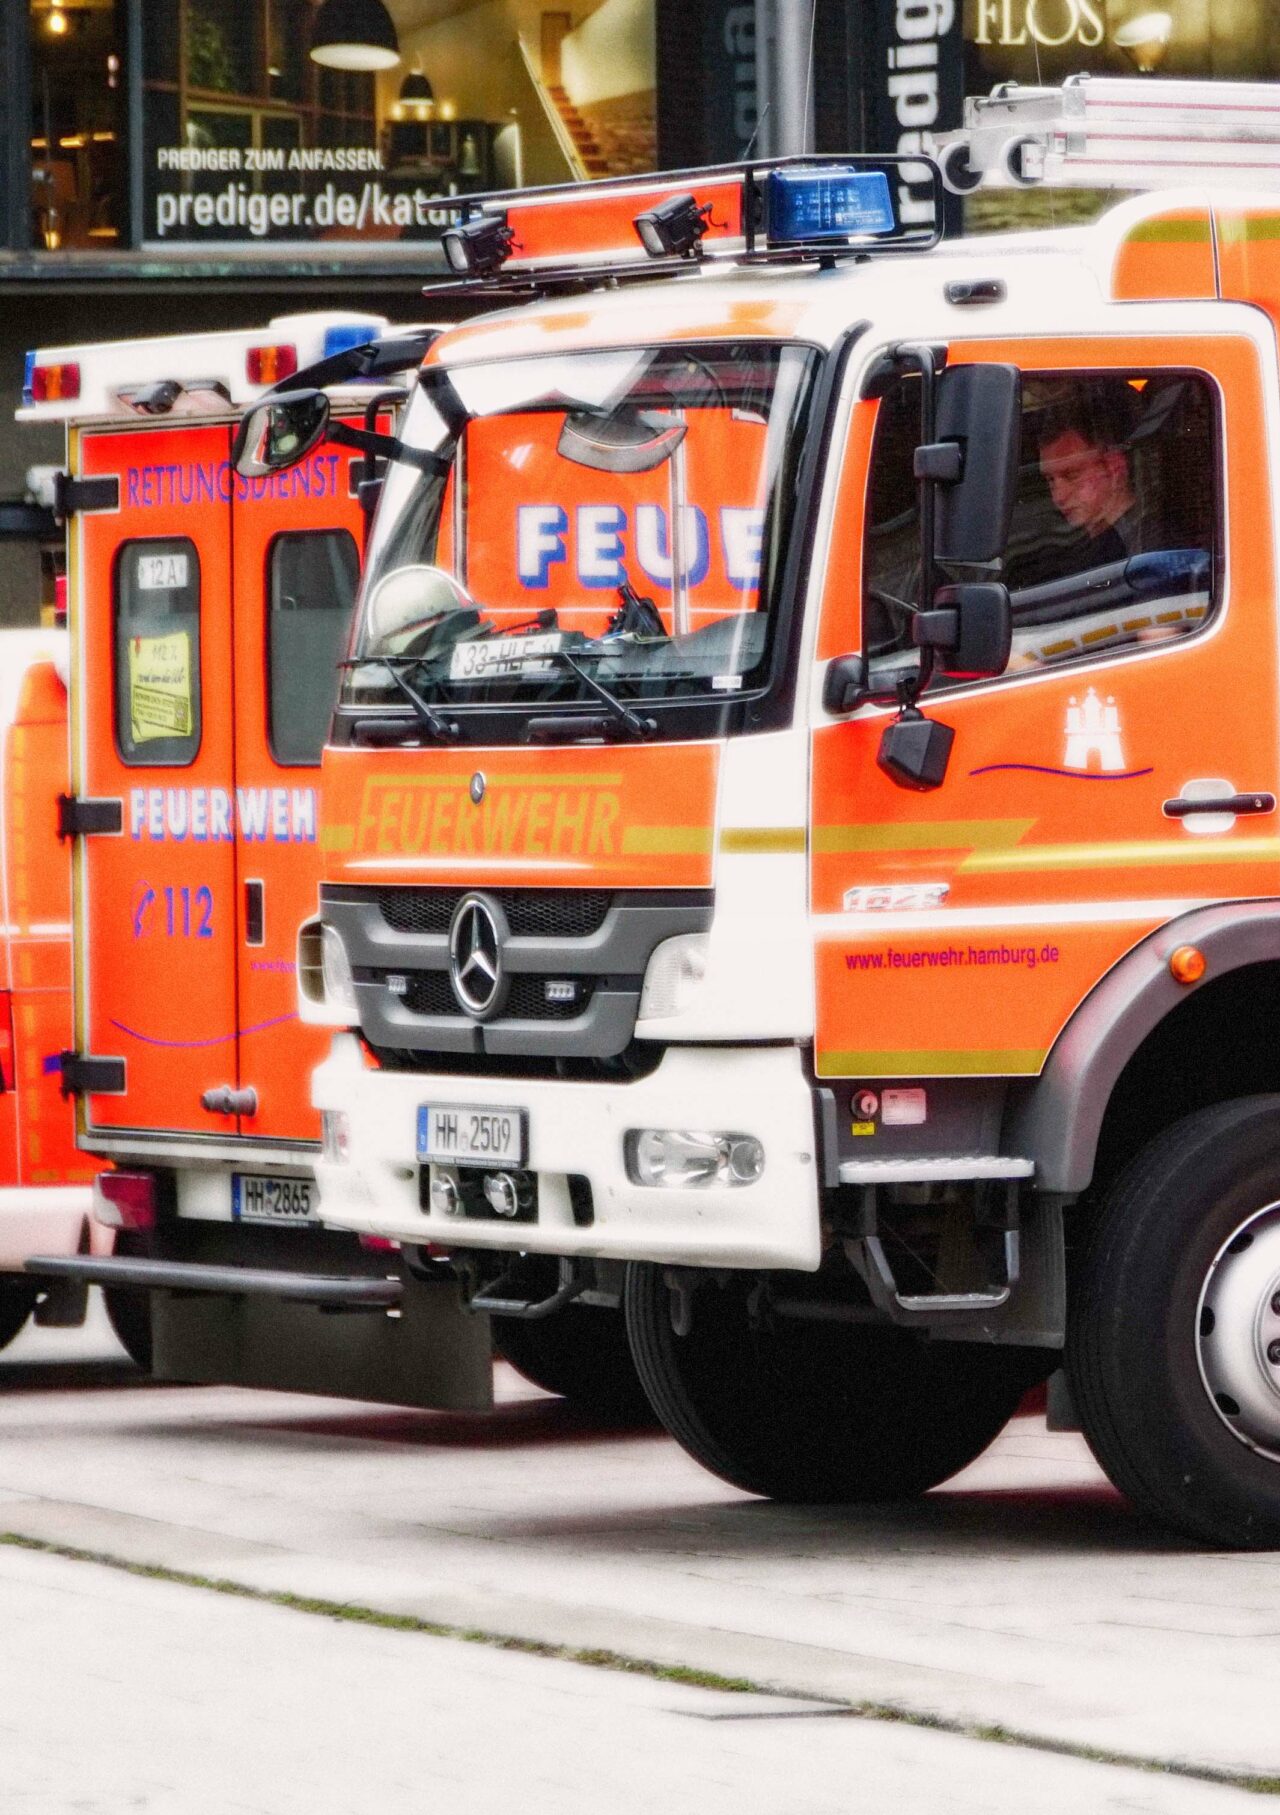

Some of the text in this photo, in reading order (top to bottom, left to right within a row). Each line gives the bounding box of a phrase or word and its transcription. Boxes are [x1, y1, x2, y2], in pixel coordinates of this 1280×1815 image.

[975, 0, 1105, 46] FLOS
[888, 0, 955, 240] redig
[157, 147, 384, 171] PREDIGER ZUM ANFASSEN.
[157, 182, 461, 236] prediger.de/katal
[357, 774, 621, 854] FEUERWEHR
[165, 886, 214, 938] 112
[845, 944, 1060, 970] www.feuerwehr.hamburg.de
[435, 1113, 511, 1153] HH 2509
[245, 1180, 310, 1215] HH 2865
